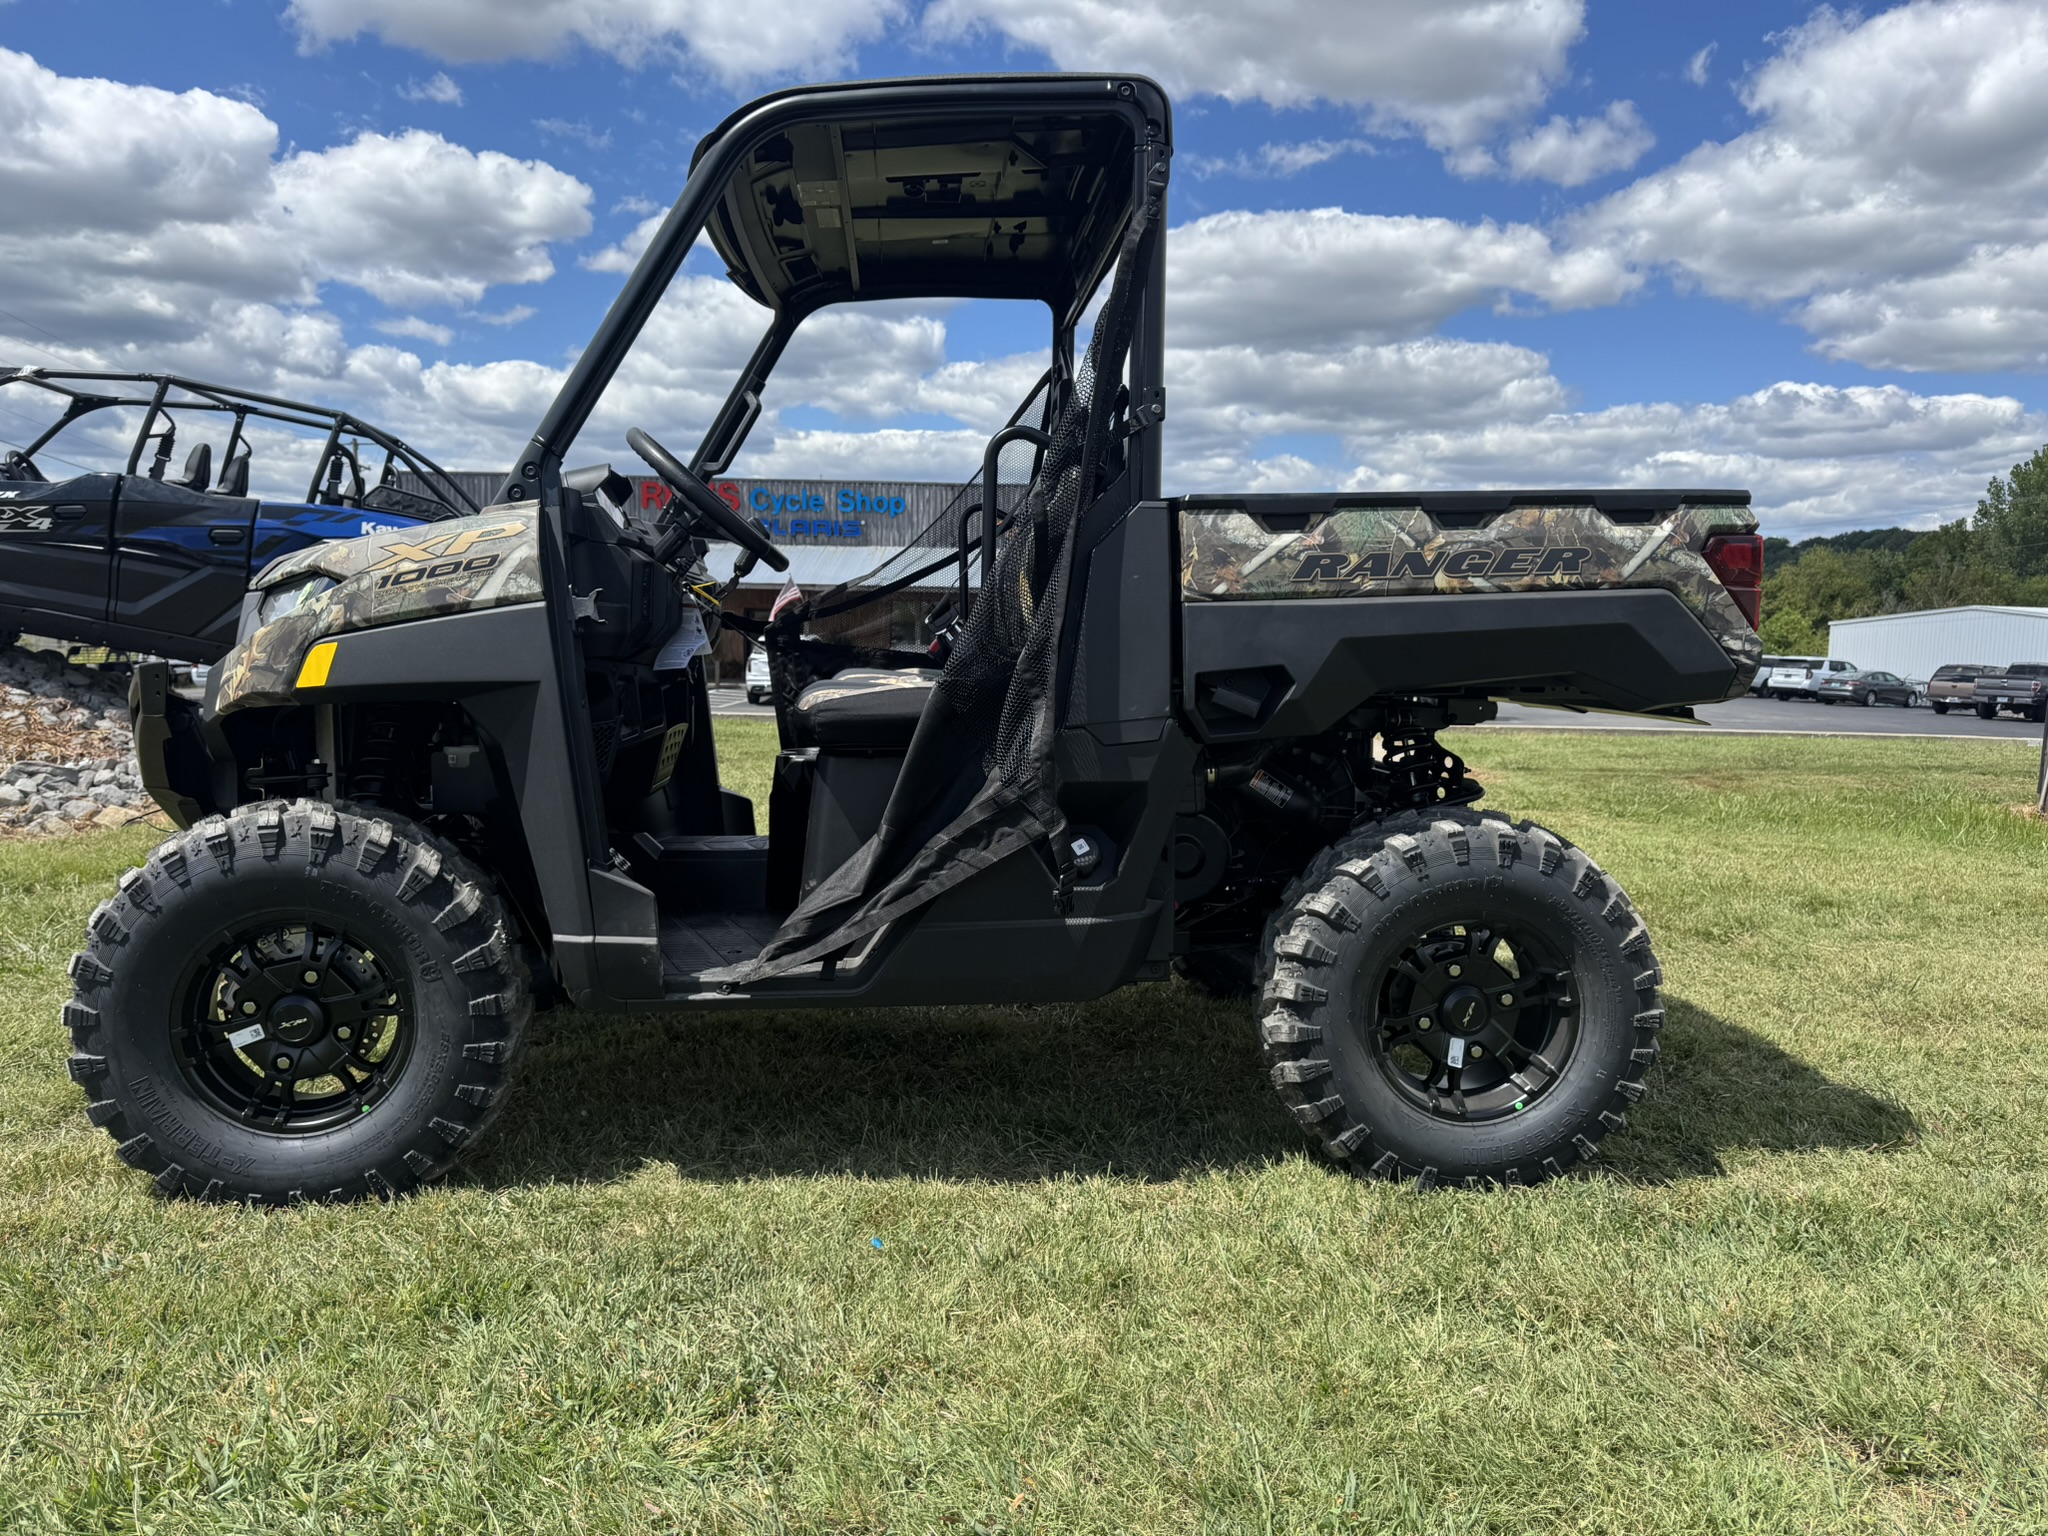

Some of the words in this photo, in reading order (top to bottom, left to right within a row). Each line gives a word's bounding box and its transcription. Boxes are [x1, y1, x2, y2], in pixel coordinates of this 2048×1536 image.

[750, 487, 824, 515] Cycle
[837, 489, 906, 518] Shop
[361, 521, 528, 574] XP
[1290, 546, 1592, 582] RANGER
[377, 553, 501, 590] 1000
[129, 1075, 257, 1178] X-TERRAIN
[1462, 1100, 1590, 1166] X-TERRAIN
